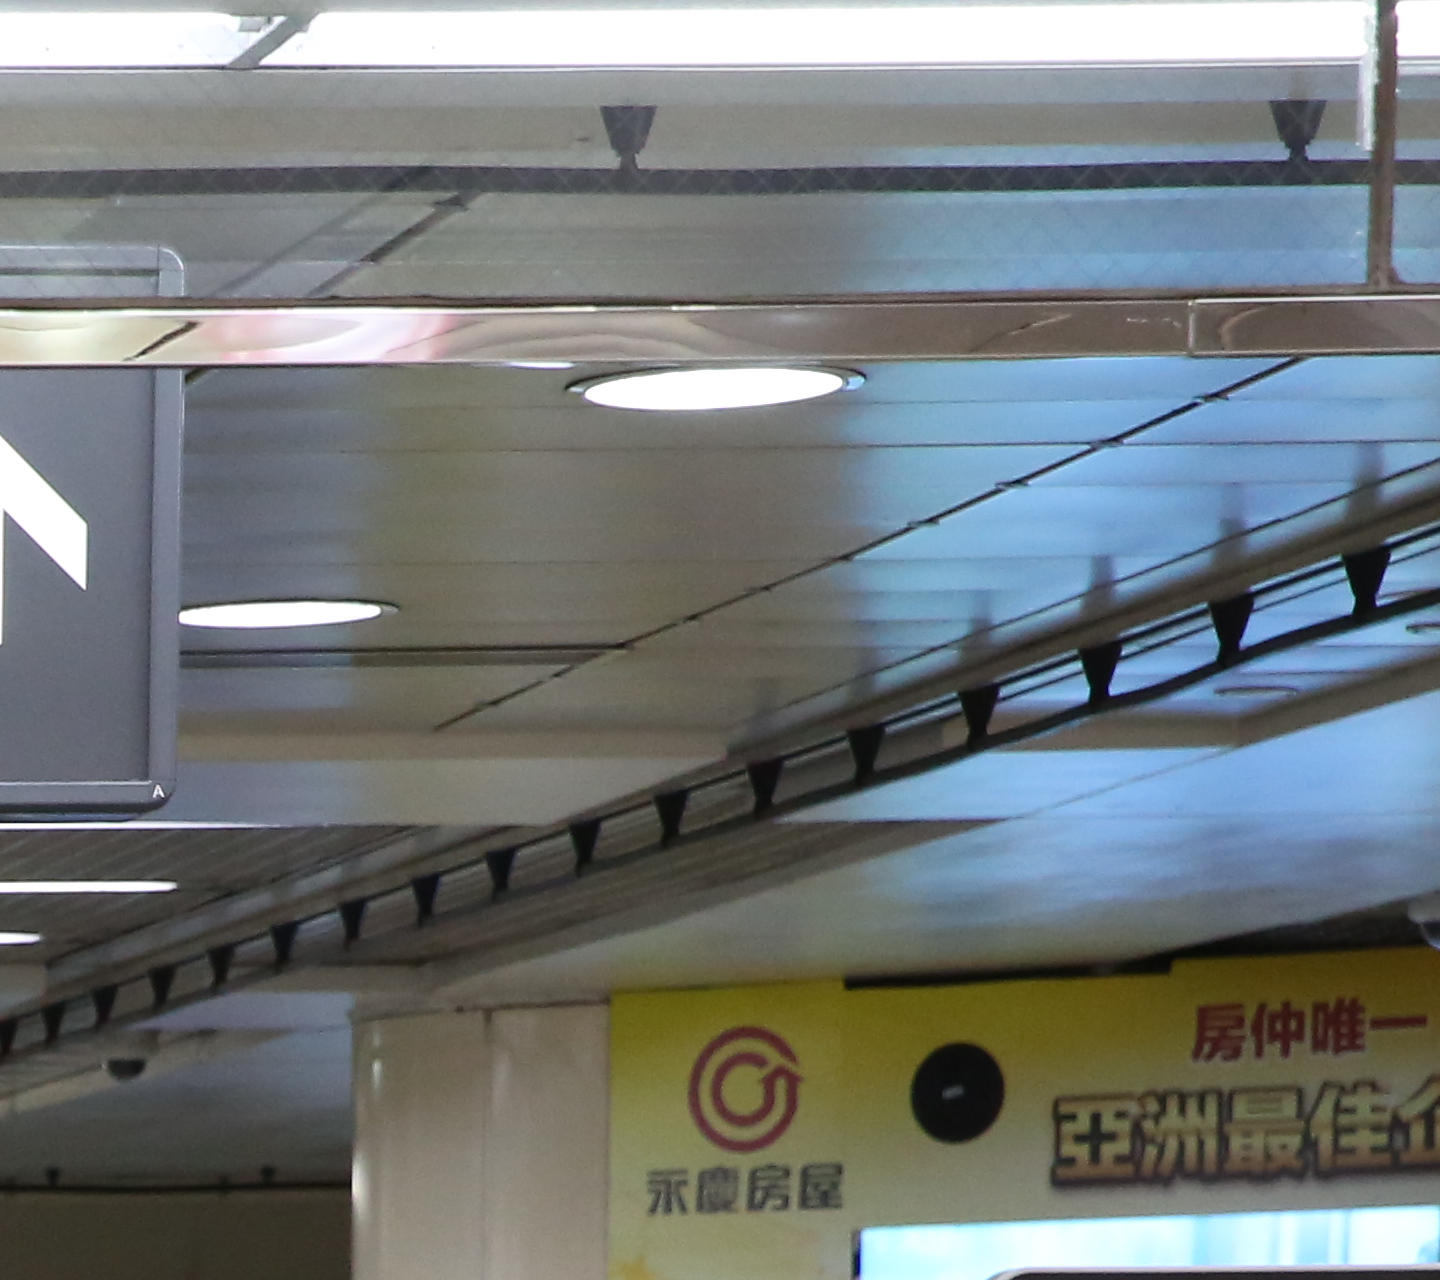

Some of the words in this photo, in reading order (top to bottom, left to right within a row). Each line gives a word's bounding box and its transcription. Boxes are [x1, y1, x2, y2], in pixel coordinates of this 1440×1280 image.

[152, 784, 165, 798] A
[1191, 997, 1428, 1062] 房仲唯一
[646, 1162, 844, 1217] 永慶房屋
